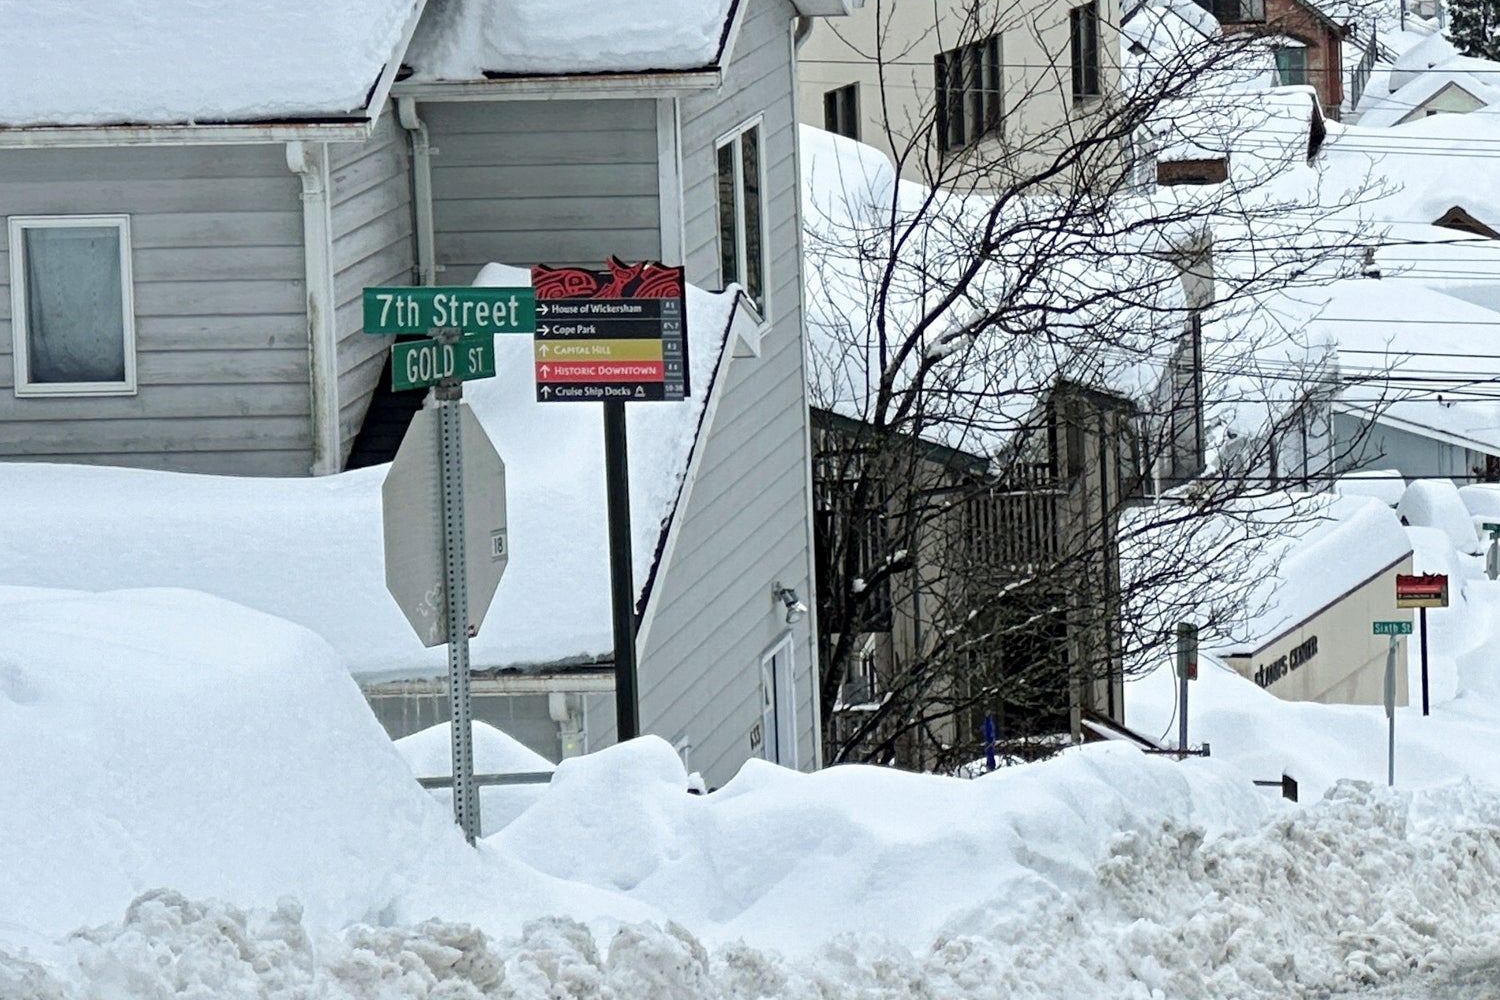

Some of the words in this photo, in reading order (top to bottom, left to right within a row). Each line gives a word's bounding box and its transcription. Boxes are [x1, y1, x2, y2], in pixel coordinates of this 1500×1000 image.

[376, 294, 419, 327] 7th
[432, 293, 519, 327] Street
[551, 304, 578, 313] House
[579, 304, 590, 313] of
[590, 303, 642, 313] Wickersham
[552, 324, 575, 335] Cope
[577, 325, 596, 334] Park
[406, 344, 455, 383] GOLD
[468, 347, 484, 374] ST
[554, 366, 596, 376] HISTORIC
[597, 366, 657, 375] DOWNTOWN
[555, 386, 583, 396] Cruise
[584, 386, 604, 398] Ship
[604, 386, 631, 396] Docks
[494, 536, 503, 554] 18
[1374, 622, 1399, 634] Sixth
[1401, 622, 1411, 634] St
